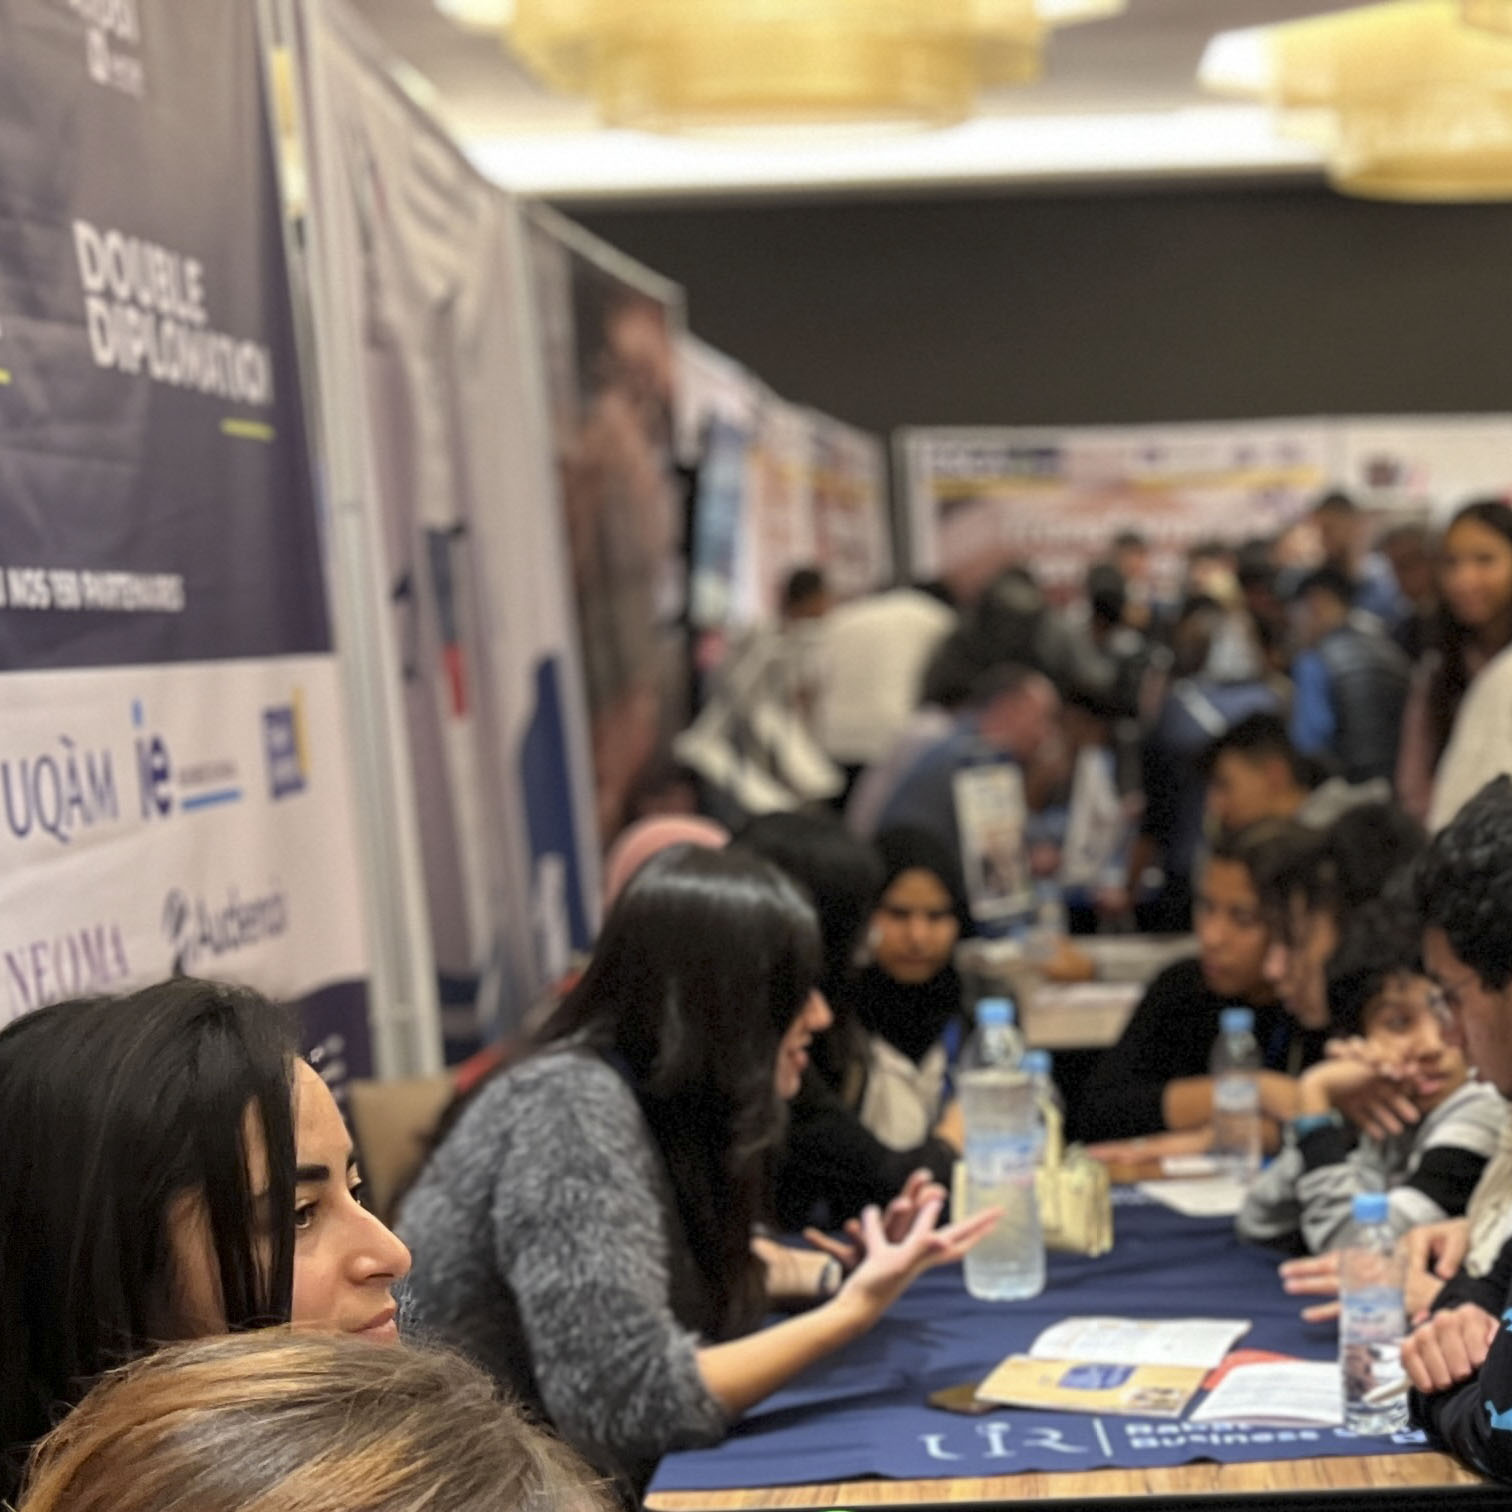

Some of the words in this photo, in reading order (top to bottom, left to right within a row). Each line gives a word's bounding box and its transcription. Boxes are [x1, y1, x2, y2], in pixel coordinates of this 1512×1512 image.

[73, 219, 208, 323] DOUBLE
[1, 733, 120, 844] UQÀM
[1129, 1429, 1319, 1450] Business
